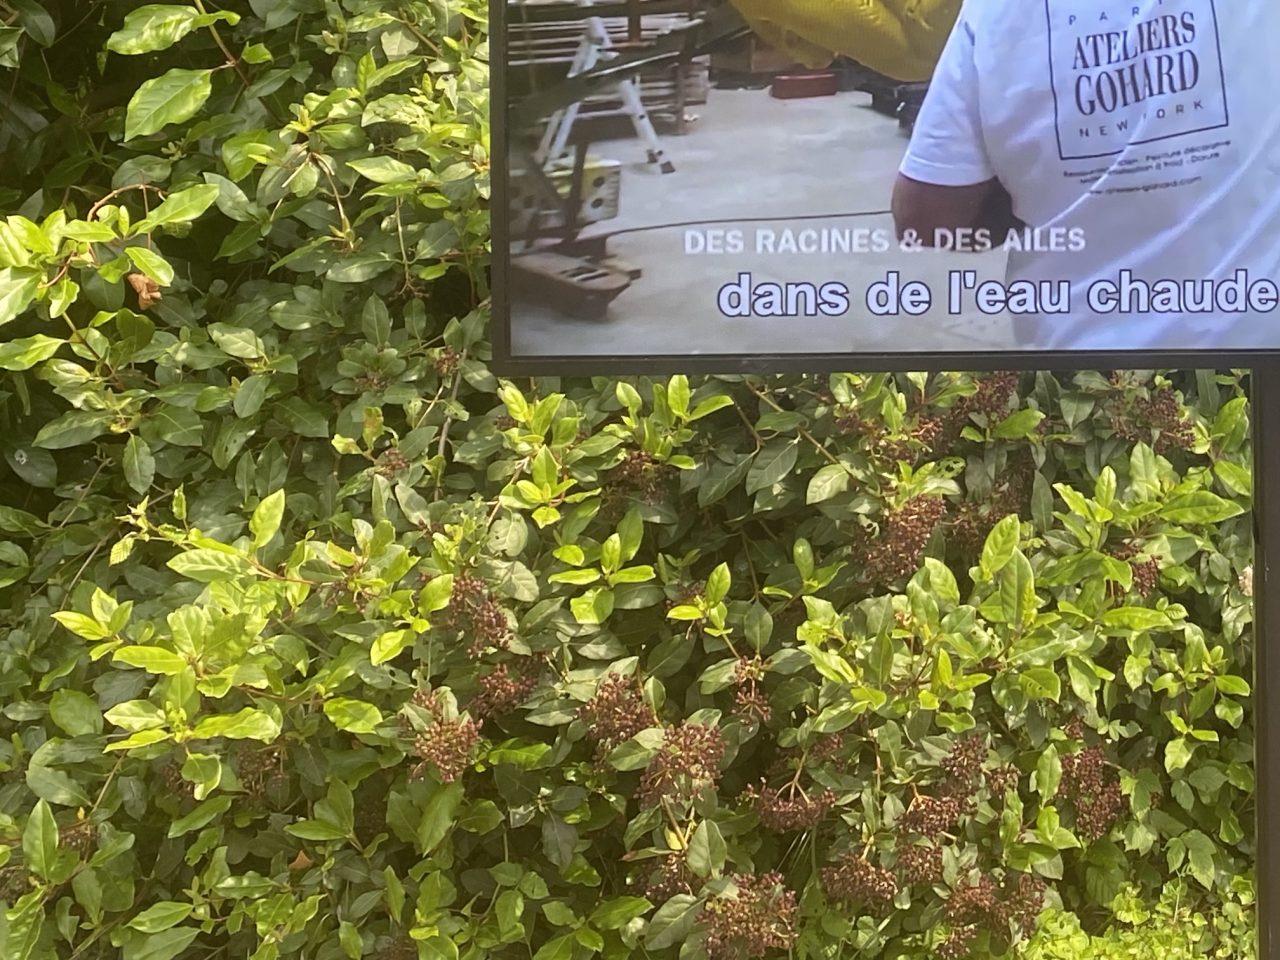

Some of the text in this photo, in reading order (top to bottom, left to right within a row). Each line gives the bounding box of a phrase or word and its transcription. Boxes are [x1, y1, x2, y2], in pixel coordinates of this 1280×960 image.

[1072, 11, 1196, 70] ATELIERS
[1075, 49, 1200, 116] GOHARD
[1079, 99, 1204, 138] NEW ORK
[684, 227, 1086, 254] DES RACINES & DES AILES
[717, 272, 849, 317] dans
[866, 271, 931, 316] de
[947, 271, 1071, 315] l'eau
[1087, 269, 1278, 314] chaude
